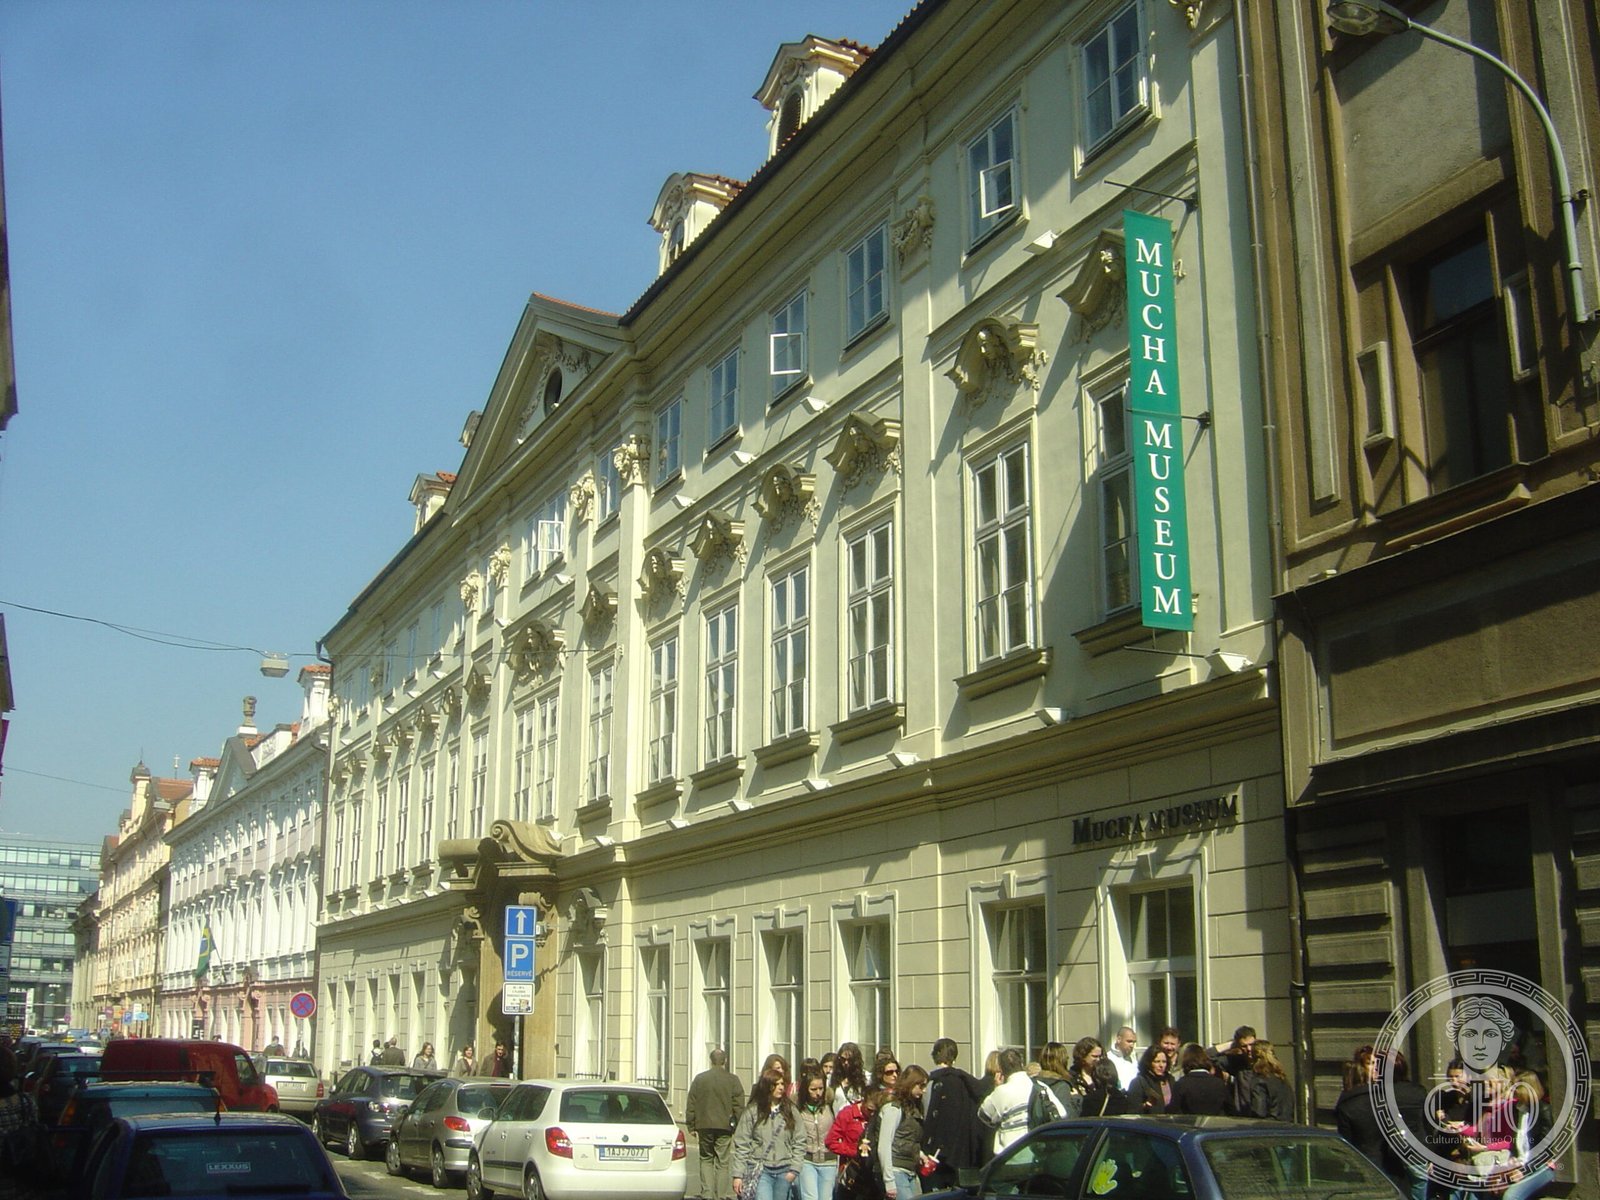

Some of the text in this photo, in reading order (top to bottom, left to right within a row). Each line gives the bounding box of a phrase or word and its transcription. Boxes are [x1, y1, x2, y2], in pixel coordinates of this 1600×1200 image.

[1136, 238, 1182, 615] MUCHA MUSEUM
[1150, 795, 1239, 832] MUSEUM
[511, 943, 529, 968] P
